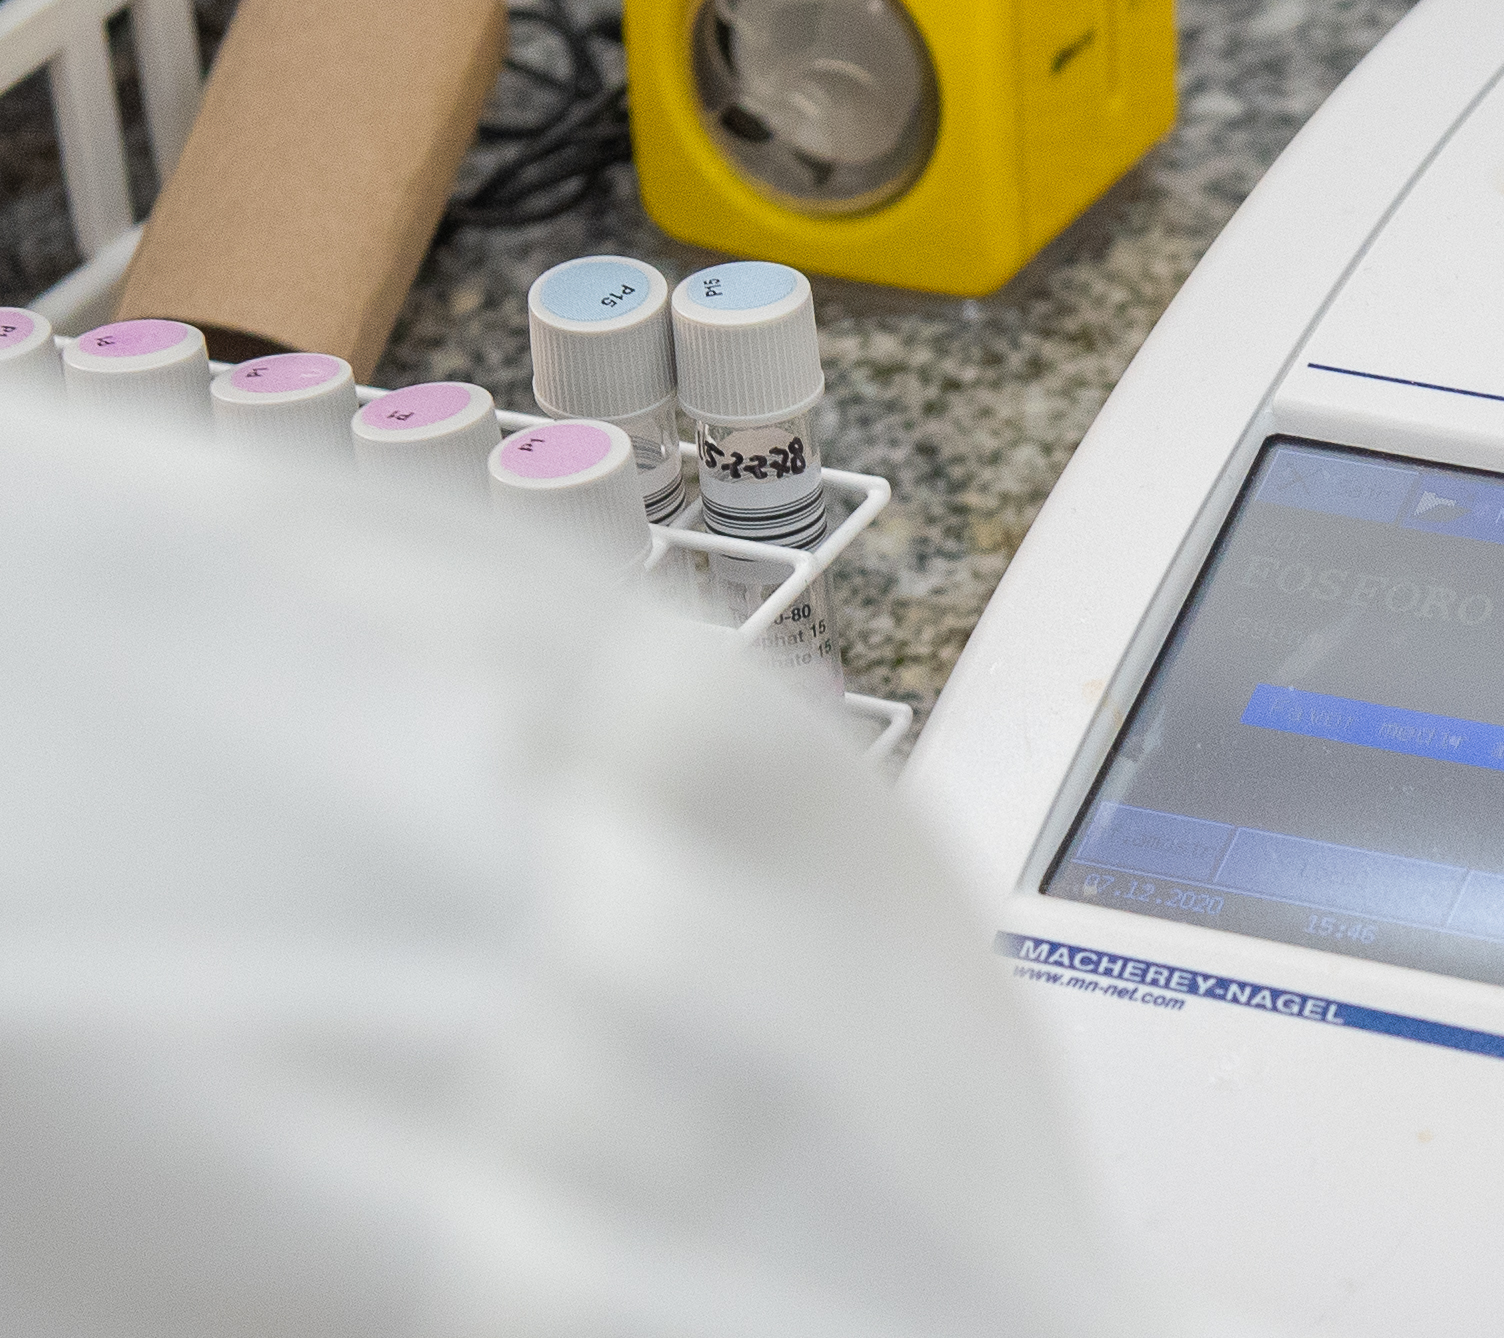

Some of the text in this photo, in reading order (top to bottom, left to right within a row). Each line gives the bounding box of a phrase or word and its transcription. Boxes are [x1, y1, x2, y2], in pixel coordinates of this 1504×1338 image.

[601, 284, 635, 308] P15
[703, 278, 724, 299] P15
[809, 618, 827, 639] 15
[818, 638, 833, 658] 15
[1082, 873, 1226, 917] 07.12.2020
[1014, 964, 1187, 1011] www.mn-net.com
[1018, 939, 1346, 1026] MACHEREY-NAGEL
